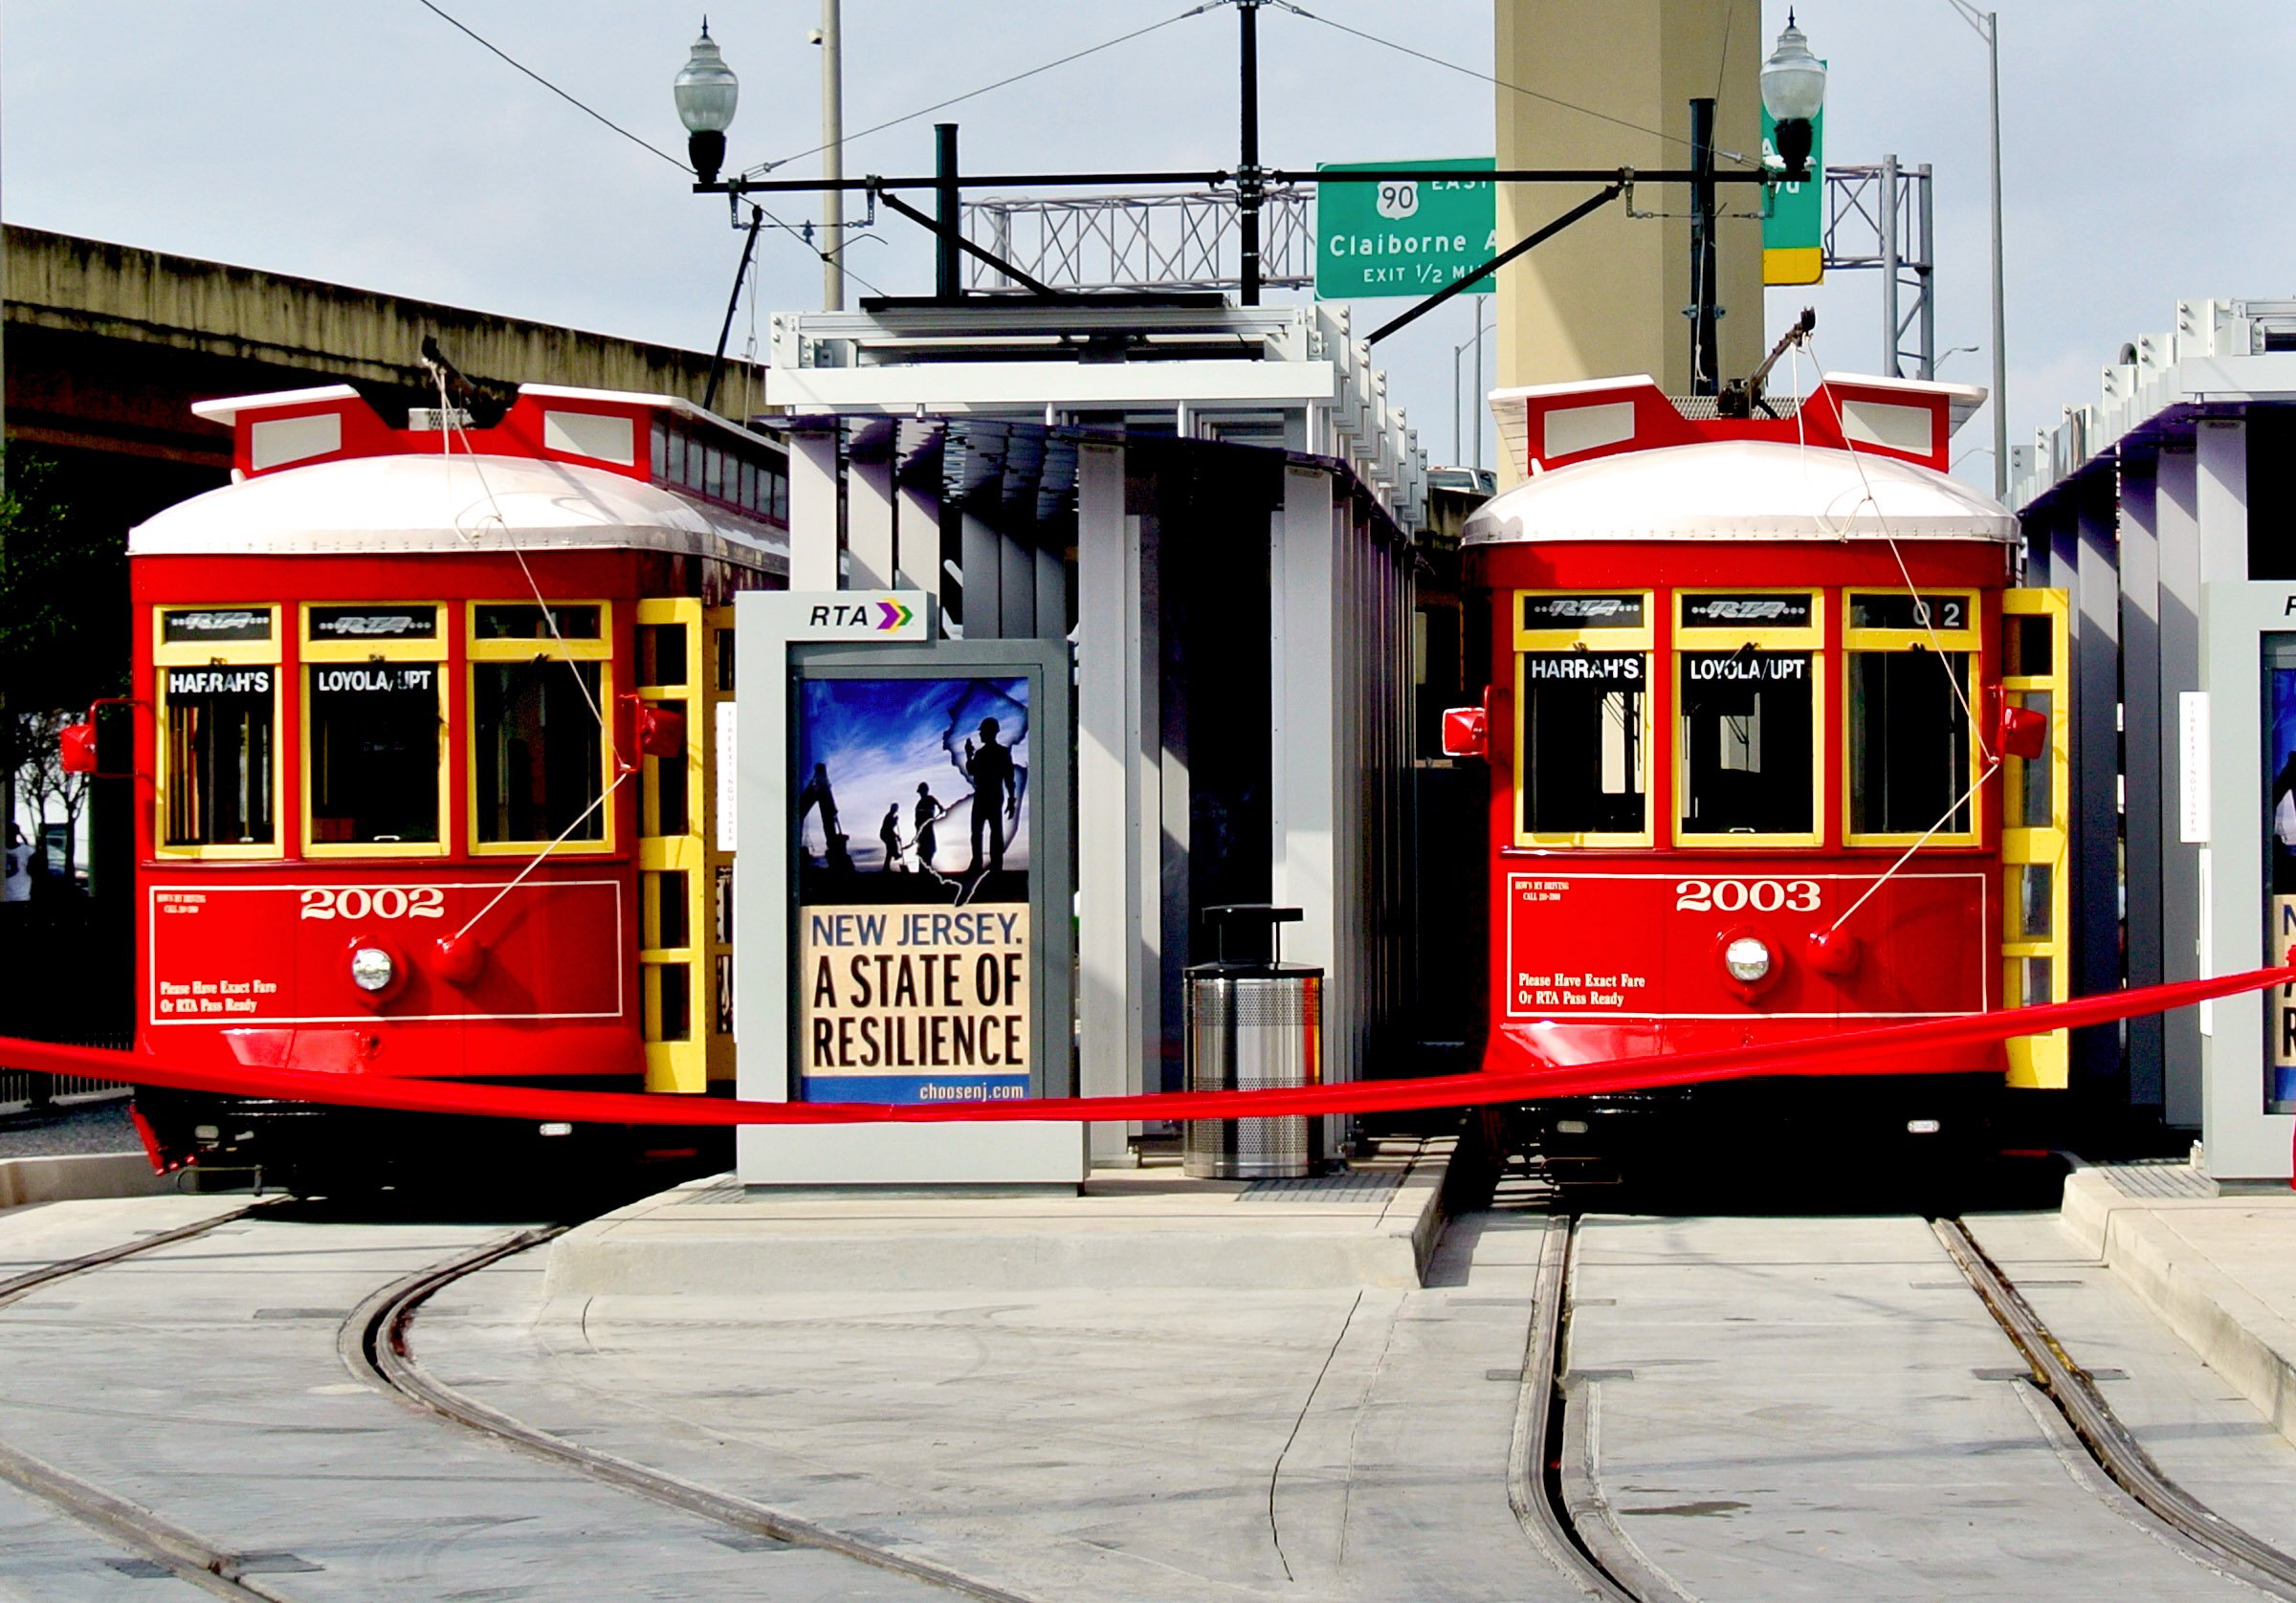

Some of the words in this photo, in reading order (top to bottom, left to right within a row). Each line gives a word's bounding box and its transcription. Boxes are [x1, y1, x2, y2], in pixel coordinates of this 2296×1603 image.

[1382, 186, 1414, 209] 90
[1330, 233, 1467, 257] Claiborne
[1363, 267, 1405, 283] EXIT
[809, 605, 869, 626] RTA
[1549, 599, 1623, 617] RTA
[1705, 601, 1786, 619] RTA
[1531, 658, 1640, 679] HARRAH'S
[299, 888, 445, 920] 2002
[1675, 880, 1821, 912] 2003
[812, 914, 887, 947] NEW
[896, 912, 1023, 946] JERSEY.
[160, 980, 191, 996] Please
[192, 980, 218, 995] Have
[220, 979, 251, 995] Exact
[253, 978, 277, 994] Fare
[813, 955, 837, 1008] A
[850, 954, 963, 1008] STATE
[975, 952, 1024, 1007] OF
[1517, 973, 1551, 987] Please
[1554, 973, 1581, 987] Have
[1584, 973, 1617, 988] Exact
[1621, 973, 1646, 988] Fare
[160, 999, 175, 1014] Or
[176, 998, 199, 1013] RTA
[200, 998, 224, 1013] Pass
[225, 998, 258, 1014] Ready
[1517, 990, 1533, 1004] Or
[1535, 990, 1559, 1005] RTA
[1562, 990, 1587, 1005] Pass
[1590, 991, 1625, 1008] Ready
[813, 1014, 1024, 1067] RESILIENCE
[918, 1082, 1025, 1103] choosenj.com
